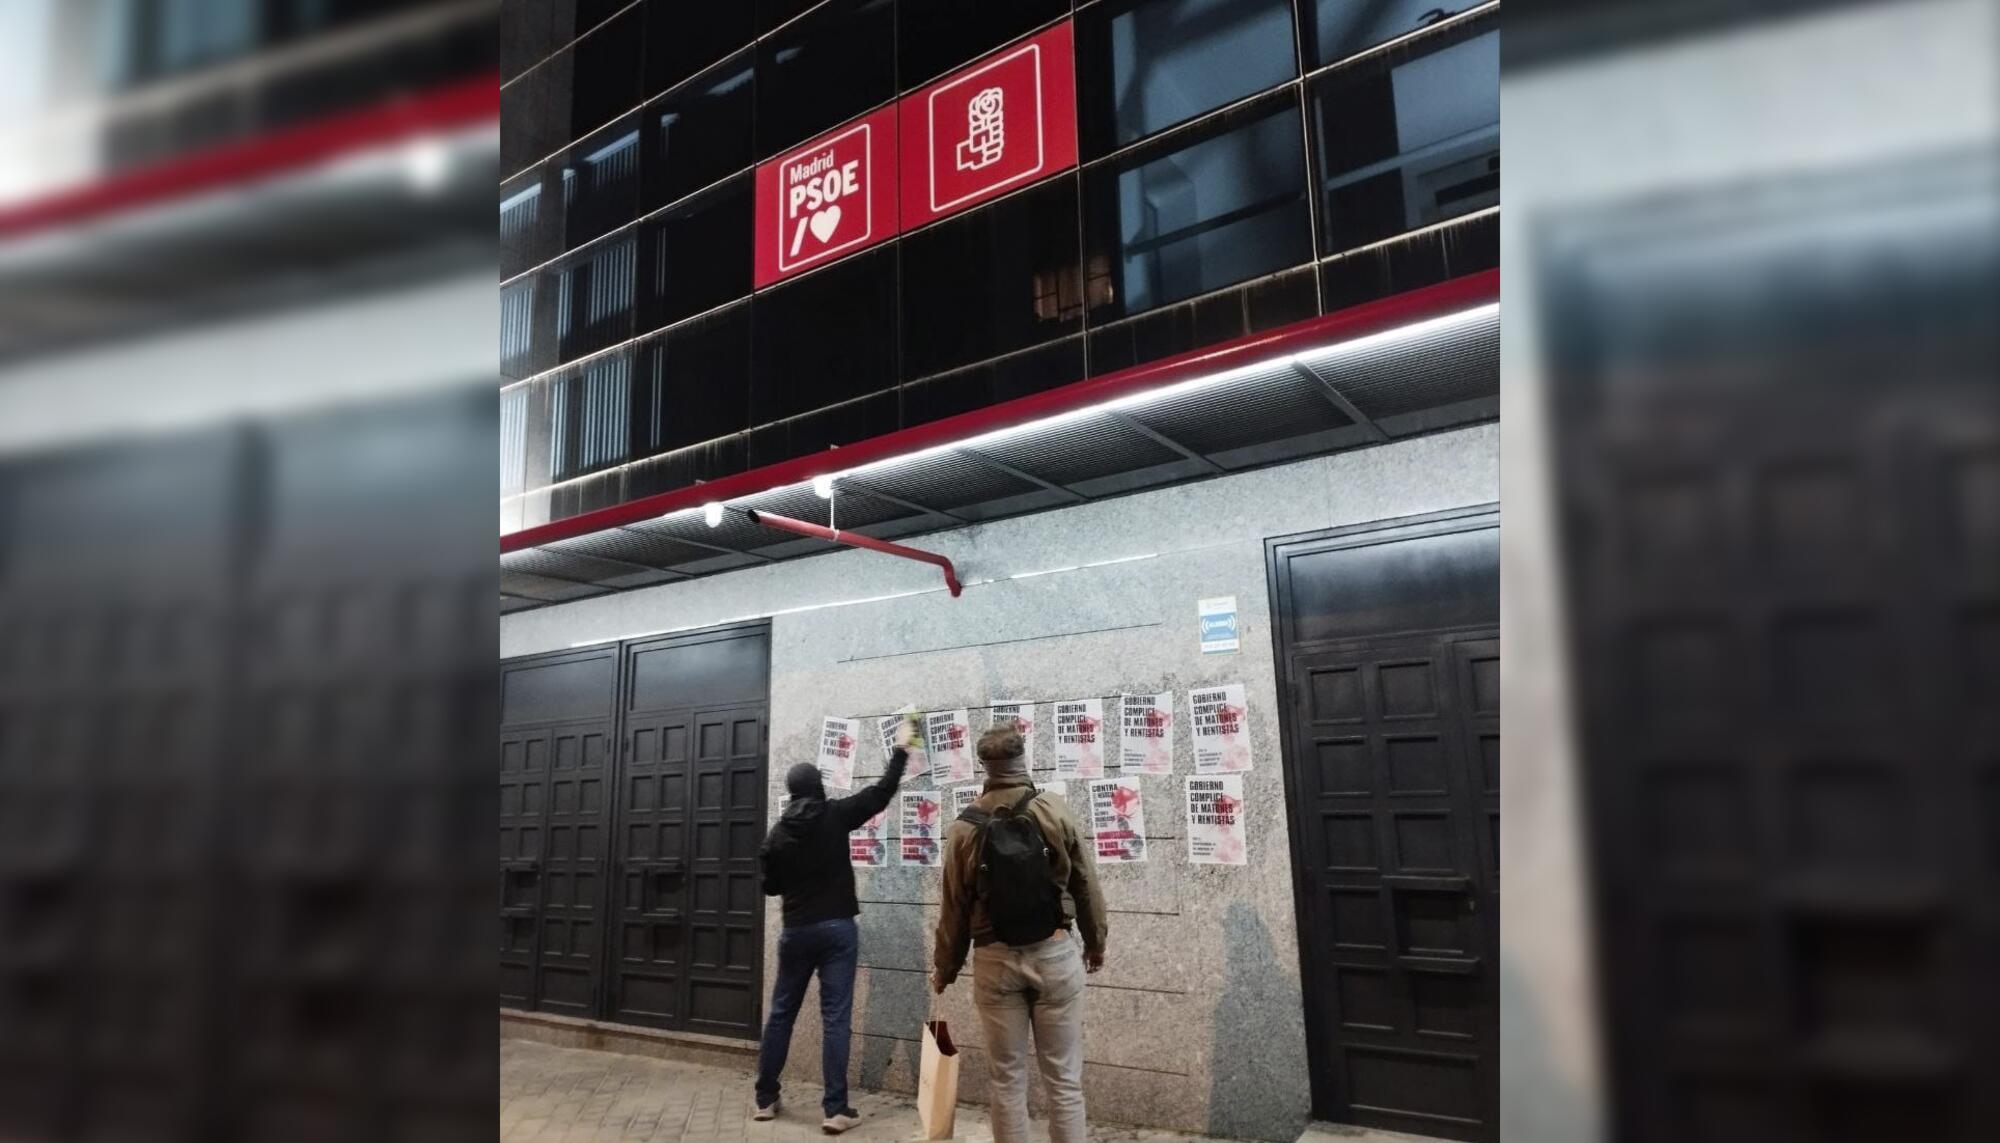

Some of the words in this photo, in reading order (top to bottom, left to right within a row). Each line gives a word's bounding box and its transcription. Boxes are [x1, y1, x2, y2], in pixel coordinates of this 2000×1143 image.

[790, 148, 834, 185] Madrid
[790, 160, 859, 219] PSOE
[1124, 696, 1156, 706] GOBIERNO
[1192, 691, 1226, 705] GOBIERNO
[1124, 717, 1132, 727] DE
[1195, 714, 1203, 726] DE
[1091, 783, 1118, 793] CONTRA
[1190, 780, 1224, 791] GOBIERNO
[902, 795, 924, 803] CONTRA
[955, 789, 978, 799] CONTRA
[1190, 803, 1199, 814] DE
